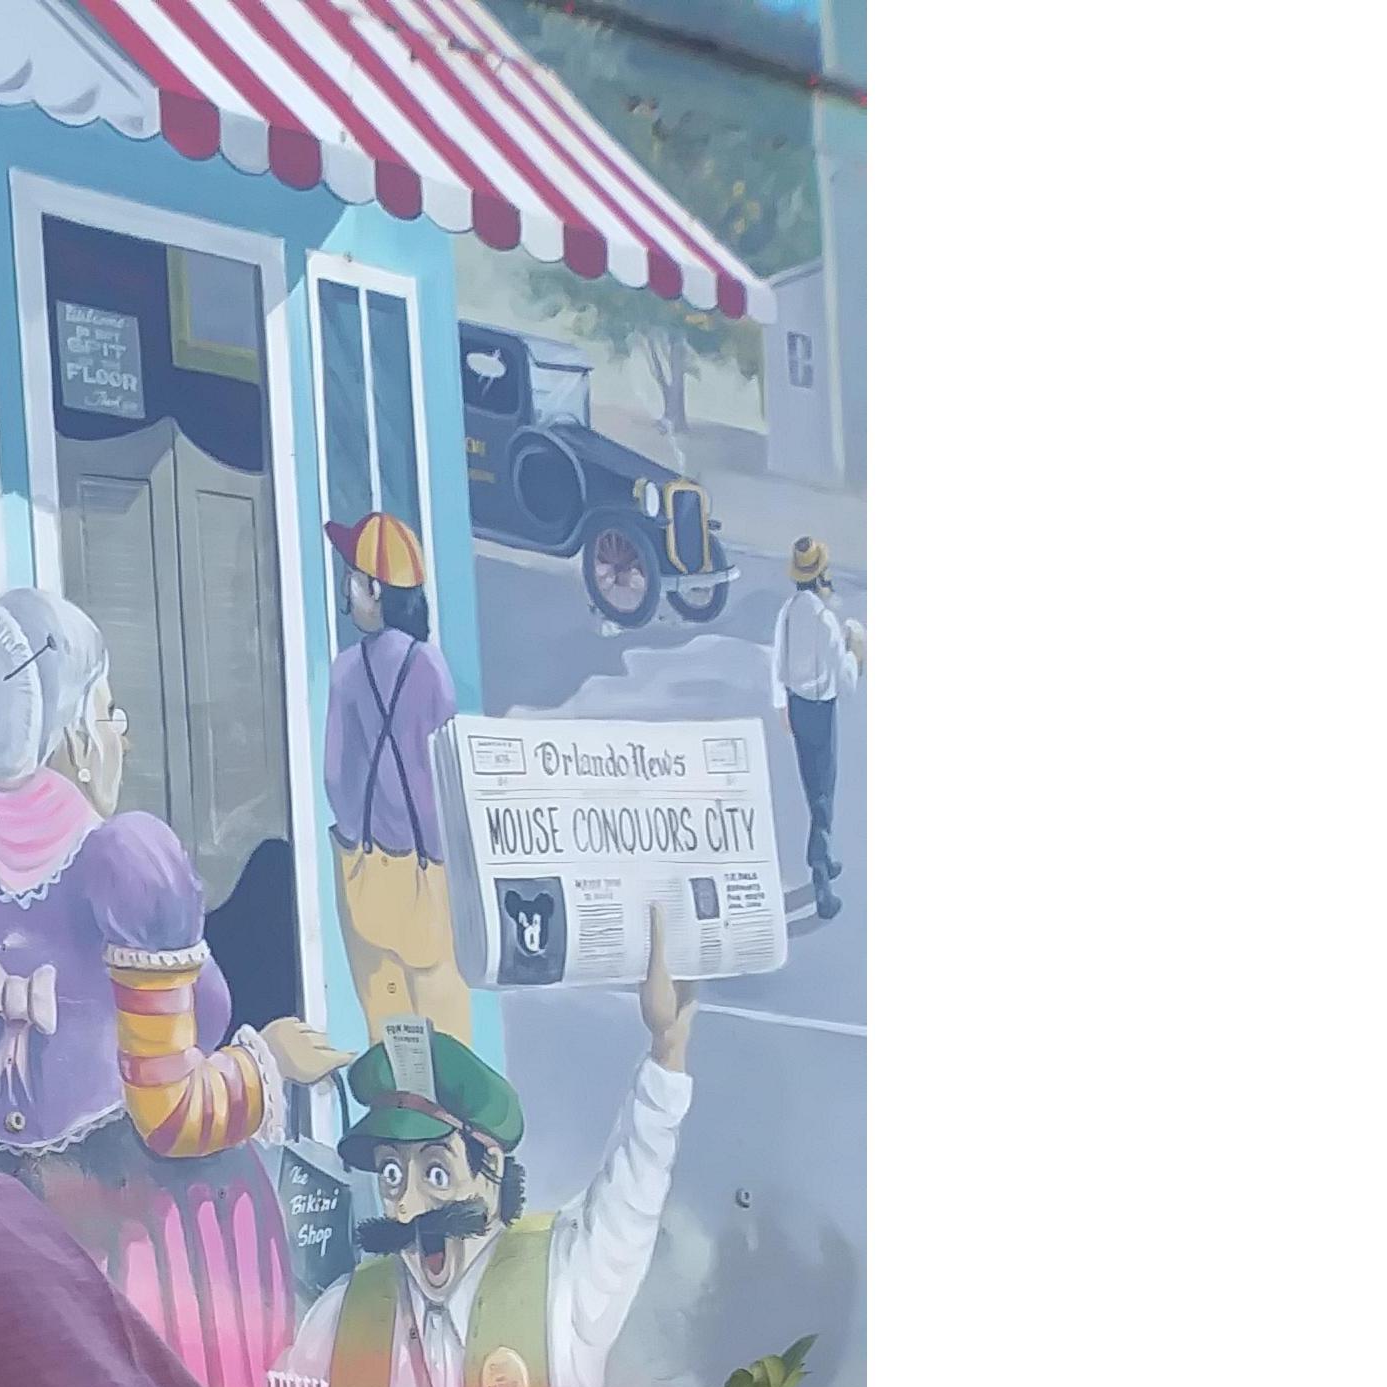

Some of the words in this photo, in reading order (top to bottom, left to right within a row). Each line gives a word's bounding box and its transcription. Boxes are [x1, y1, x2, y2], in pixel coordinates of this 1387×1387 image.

[66, 362, 138, 393] FLOOR
[534, 741, 627, 777] Orlando
[486, 806, 564, 855] MOUSE
[573, 806, 698, 855] CONQUORS
[706, 800, 754, 852] CITY
[290, 1188, 339, 1215] Bikini
[298, 1223, 332, 1257] Shop
